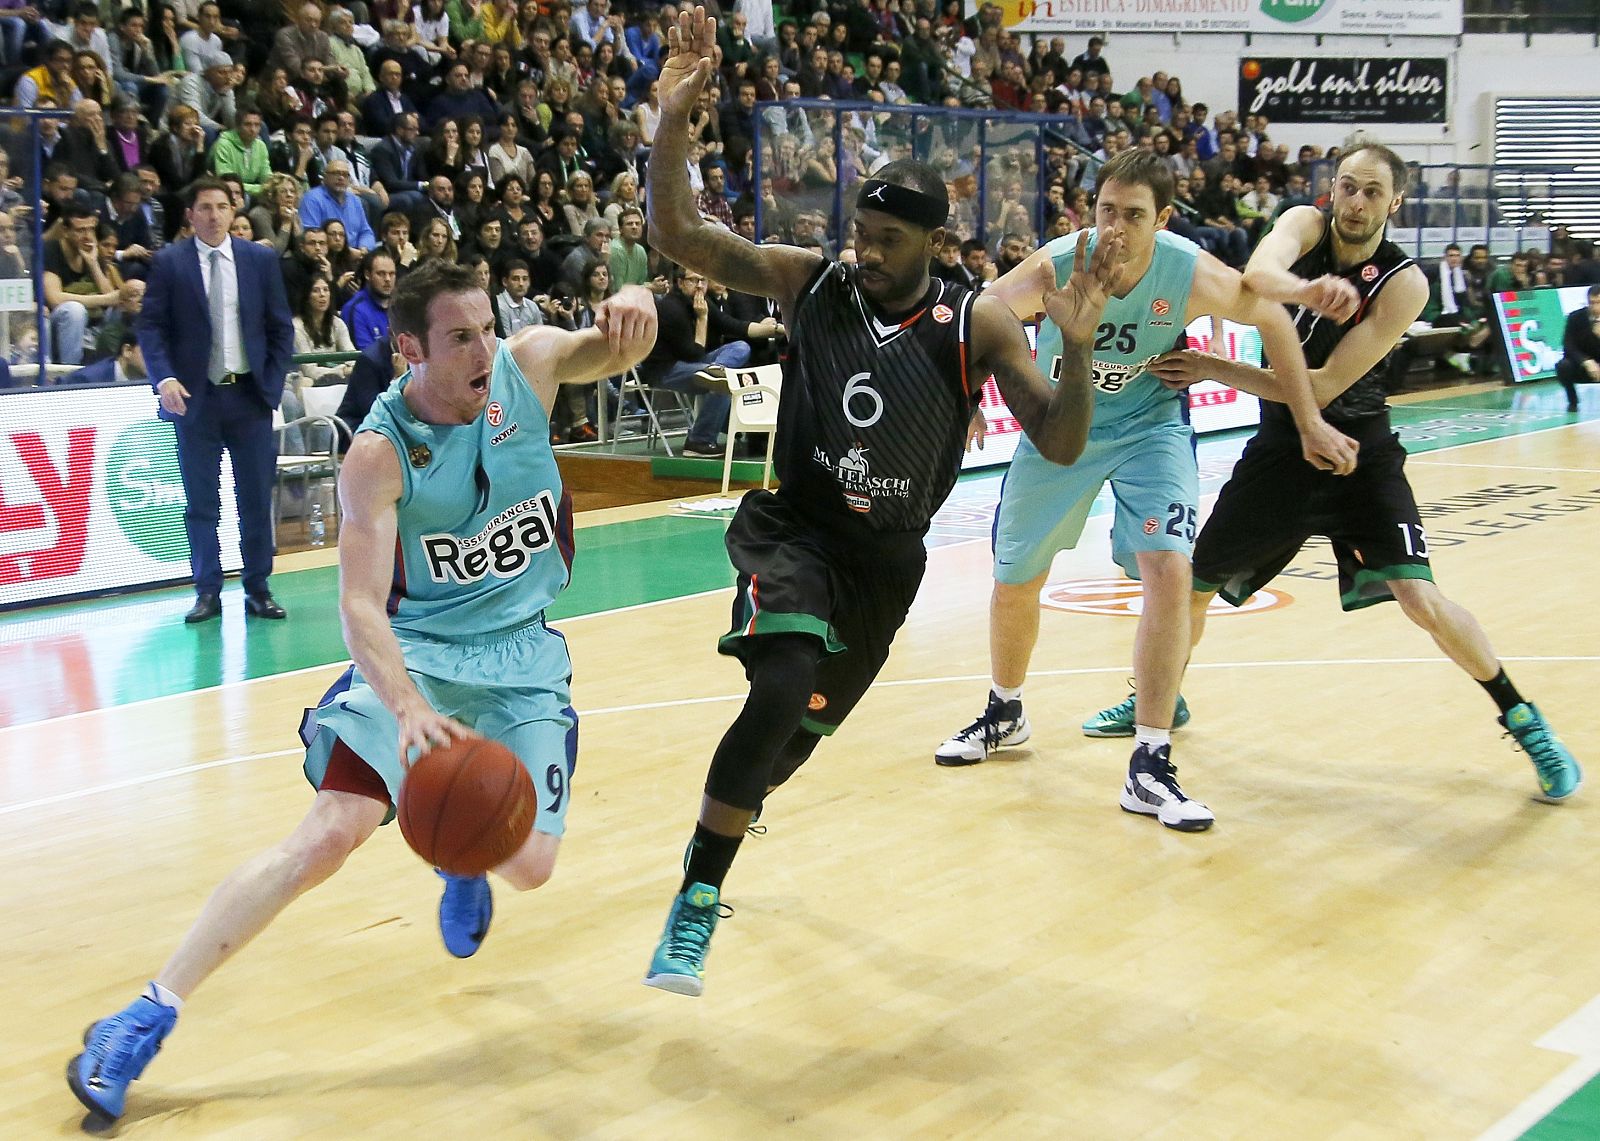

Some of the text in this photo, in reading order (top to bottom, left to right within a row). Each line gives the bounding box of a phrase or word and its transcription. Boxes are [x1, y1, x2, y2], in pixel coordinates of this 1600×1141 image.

[1059, 0, 1126, 13] ESTETICA
[1249, 60, 1444, 113] gold and silver
[1093, 322, 1138, 355] 25
[842, 372, 884, 428] 6
[424, 495, 556, 581] Regal
[1165, 502, 1197, 544] 25
[1397, 522, 1430, 559] 13
[545, 763, 564, 814] 9
